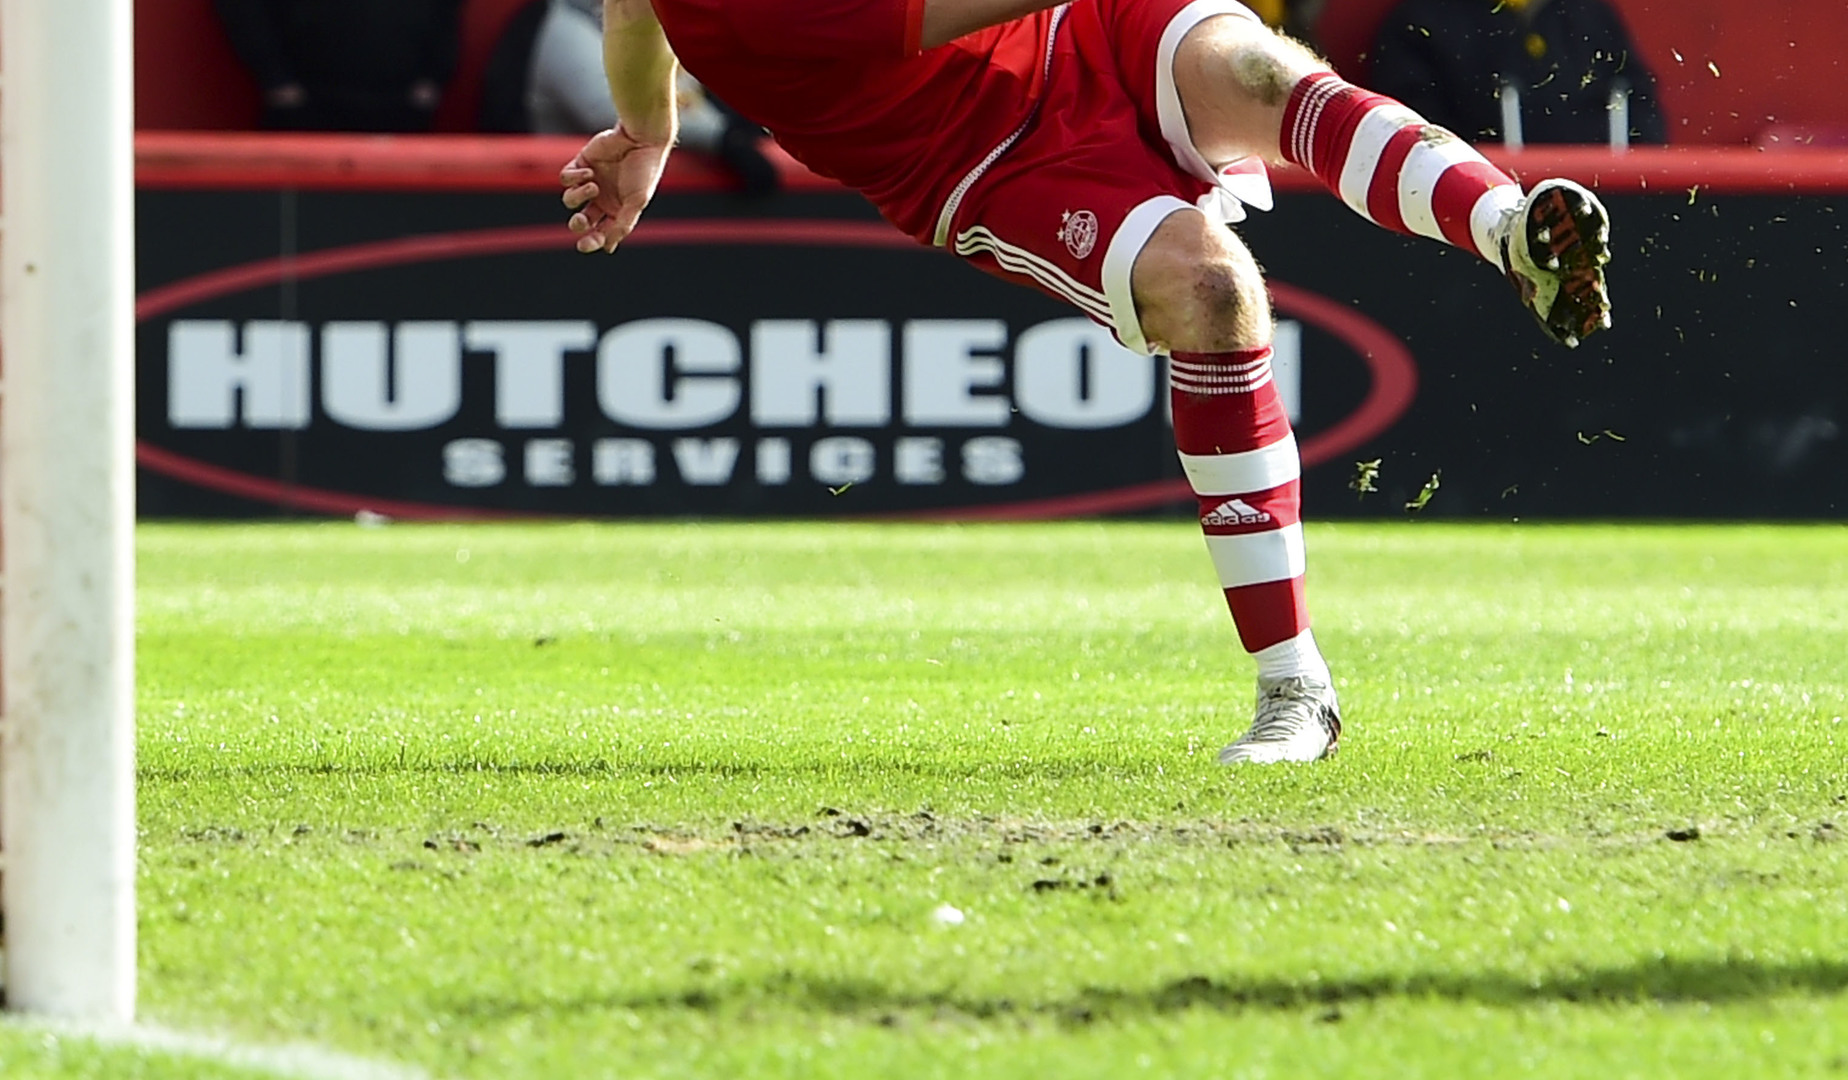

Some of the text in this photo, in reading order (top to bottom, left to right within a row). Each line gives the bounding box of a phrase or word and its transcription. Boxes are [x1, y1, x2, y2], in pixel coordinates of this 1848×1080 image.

[167, 317, 1301, 432] HUTCHEO
[442, 437, 1025, 487] SERVICES
[1201, 510, 1271, 526] adidas
